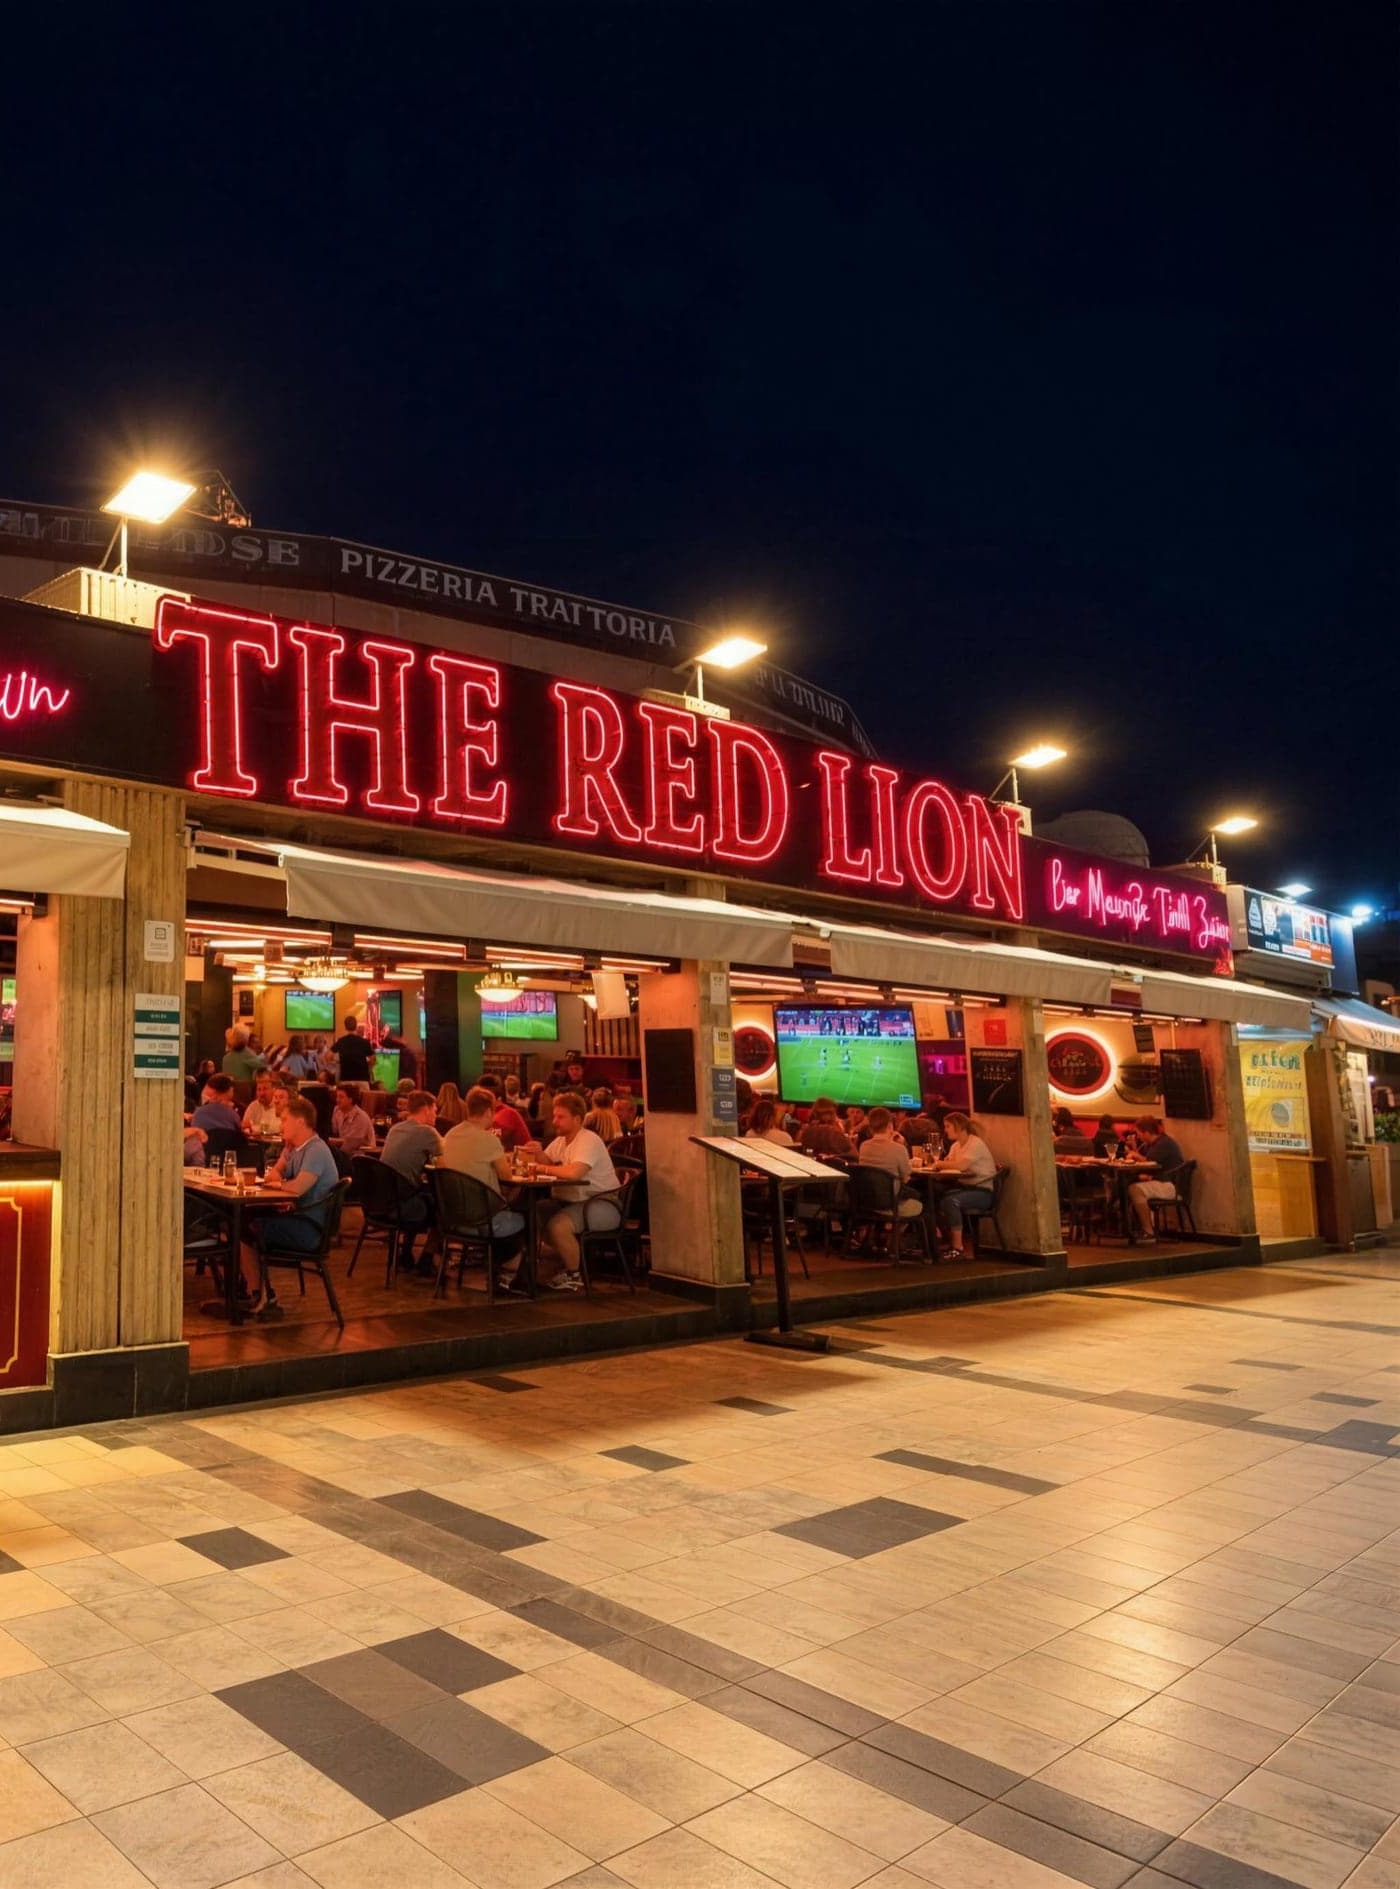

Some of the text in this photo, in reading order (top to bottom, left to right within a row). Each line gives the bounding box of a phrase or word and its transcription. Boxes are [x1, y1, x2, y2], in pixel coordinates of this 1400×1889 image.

[340, 548, 676, 648] PIZZERIA TRATTORIA
[154, 597, 1024, 921] THE RED LION
